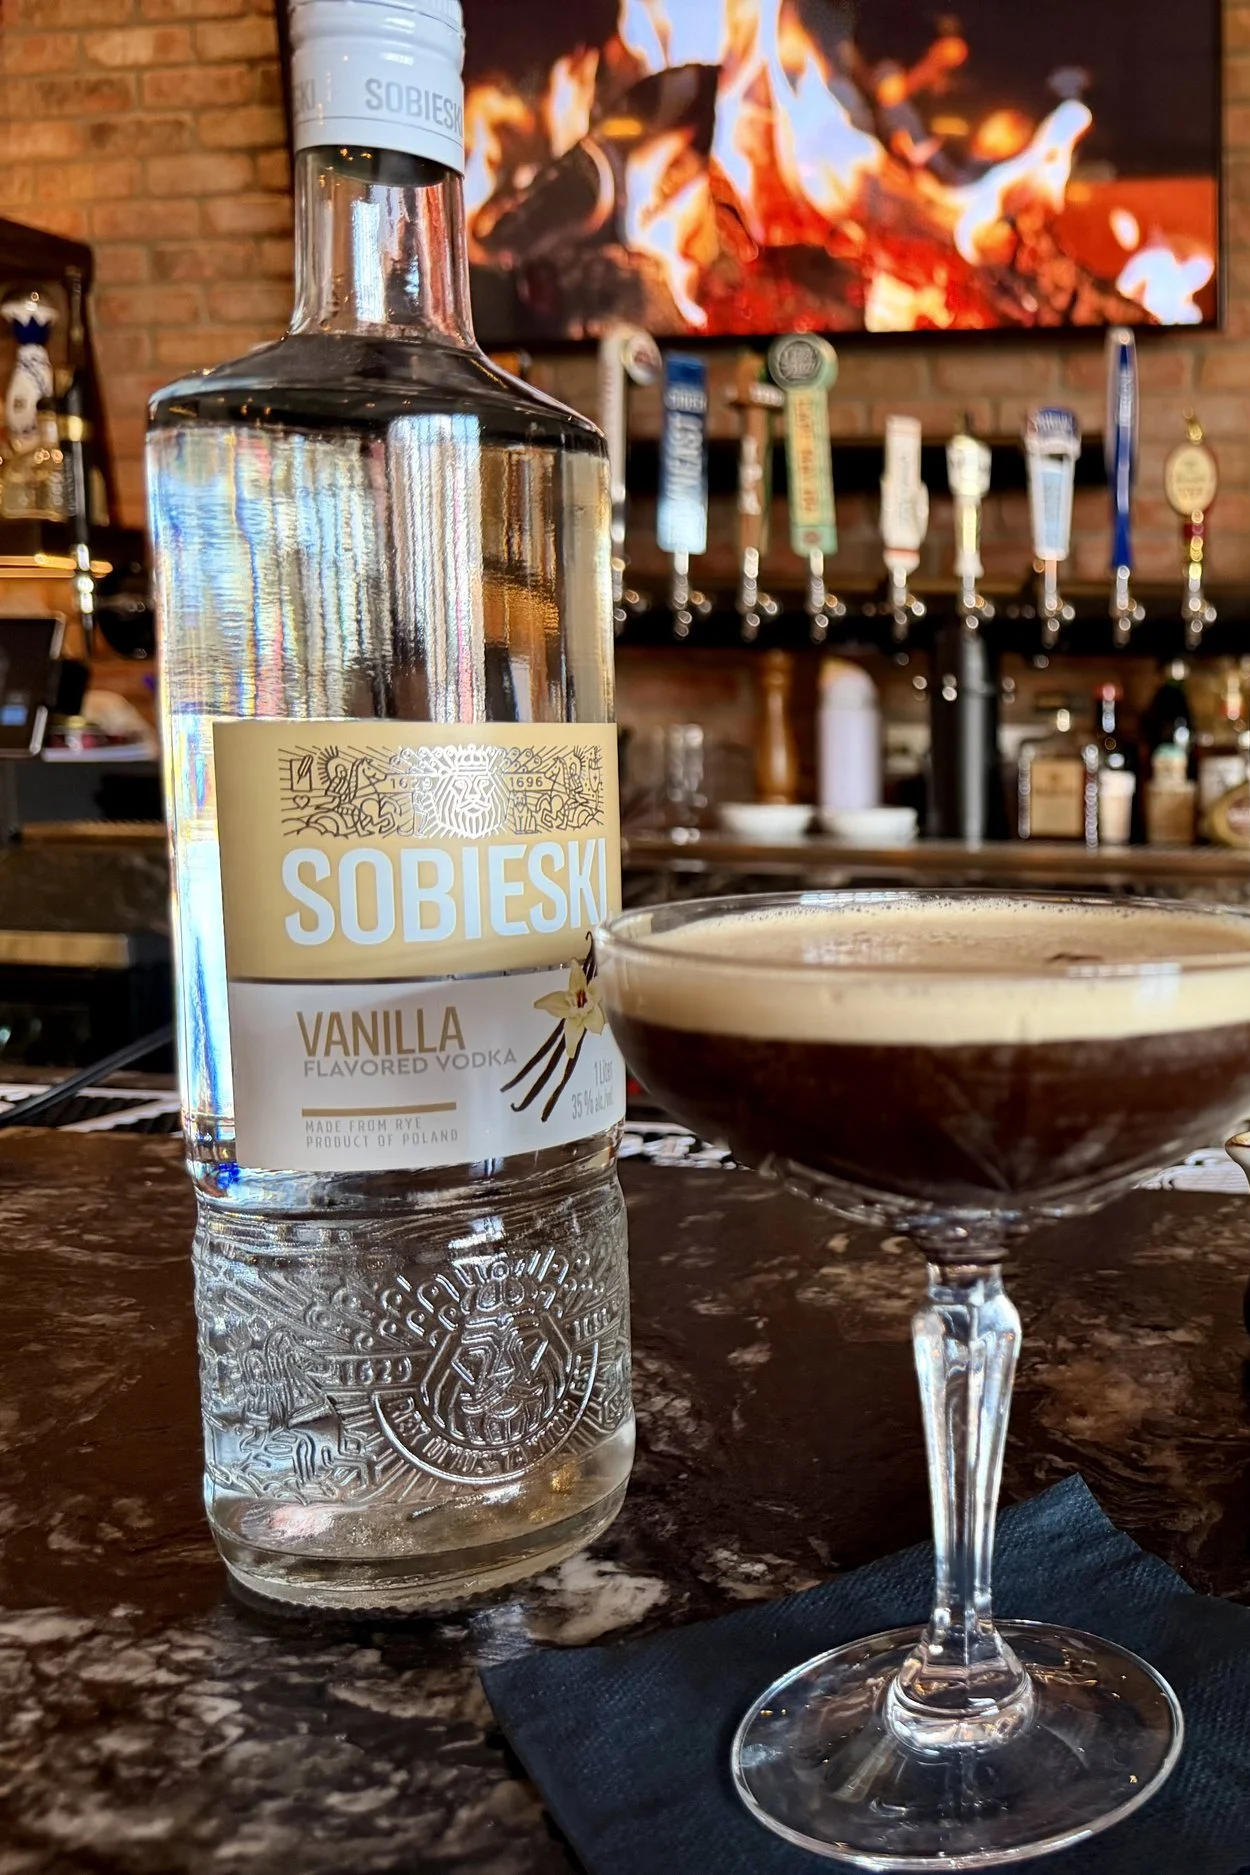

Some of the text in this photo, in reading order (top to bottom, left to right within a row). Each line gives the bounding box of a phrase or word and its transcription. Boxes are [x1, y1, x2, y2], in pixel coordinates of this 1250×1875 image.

[509, 776, 544, 788] 1696
[281, 837, 607, 946] SOBIESKI
[297, 1006, 466, 1058] VANILLA
[303, 1047, 518, 1079] FLAVORED VODKA
[305, 1116, 422, 1134] MADE FROM RYE
[306, 1128, 459, 1149] PRODUCT OF POLAND
